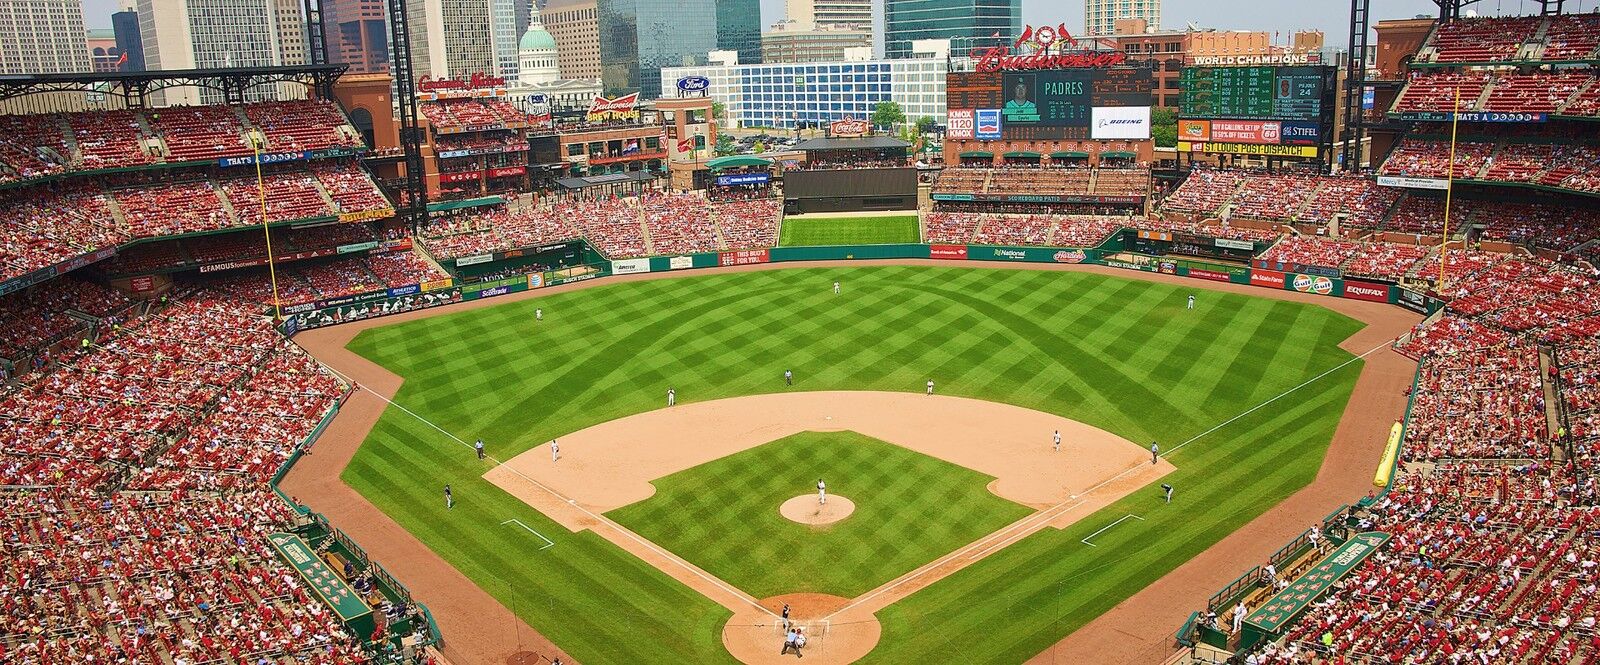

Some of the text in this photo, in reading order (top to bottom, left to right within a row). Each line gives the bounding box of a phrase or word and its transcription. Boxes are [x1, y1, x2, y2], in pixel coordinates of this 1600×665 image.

[970, 46, 1127, 73] Budweiser
[1194, 54, 1308, 65] WORLD CHAMPIONS
[418, 72, 504, 92] Cardinals Nation
[684, 78, 704, 89] Ford
[1045, 82, 1083, 95] PADRES
[591, 100, 633, 111] Budweiser
[588, 110, 640, 121] BREW HOUSE
[836, 123, 864, 134] Coca-Cola
[950, 120, 972, 128] 1120
[1293, 126, 1318, 136] STIFEL
[1205, 143, 1216, 151] ST.
[1217, 143, 1239, 152] LOUIS
[207, 263, 234, 272] FAMOUS
[482, 288, 507, 297] Scottrade
[1347, 285, 1384, 296] EQUIFAX
